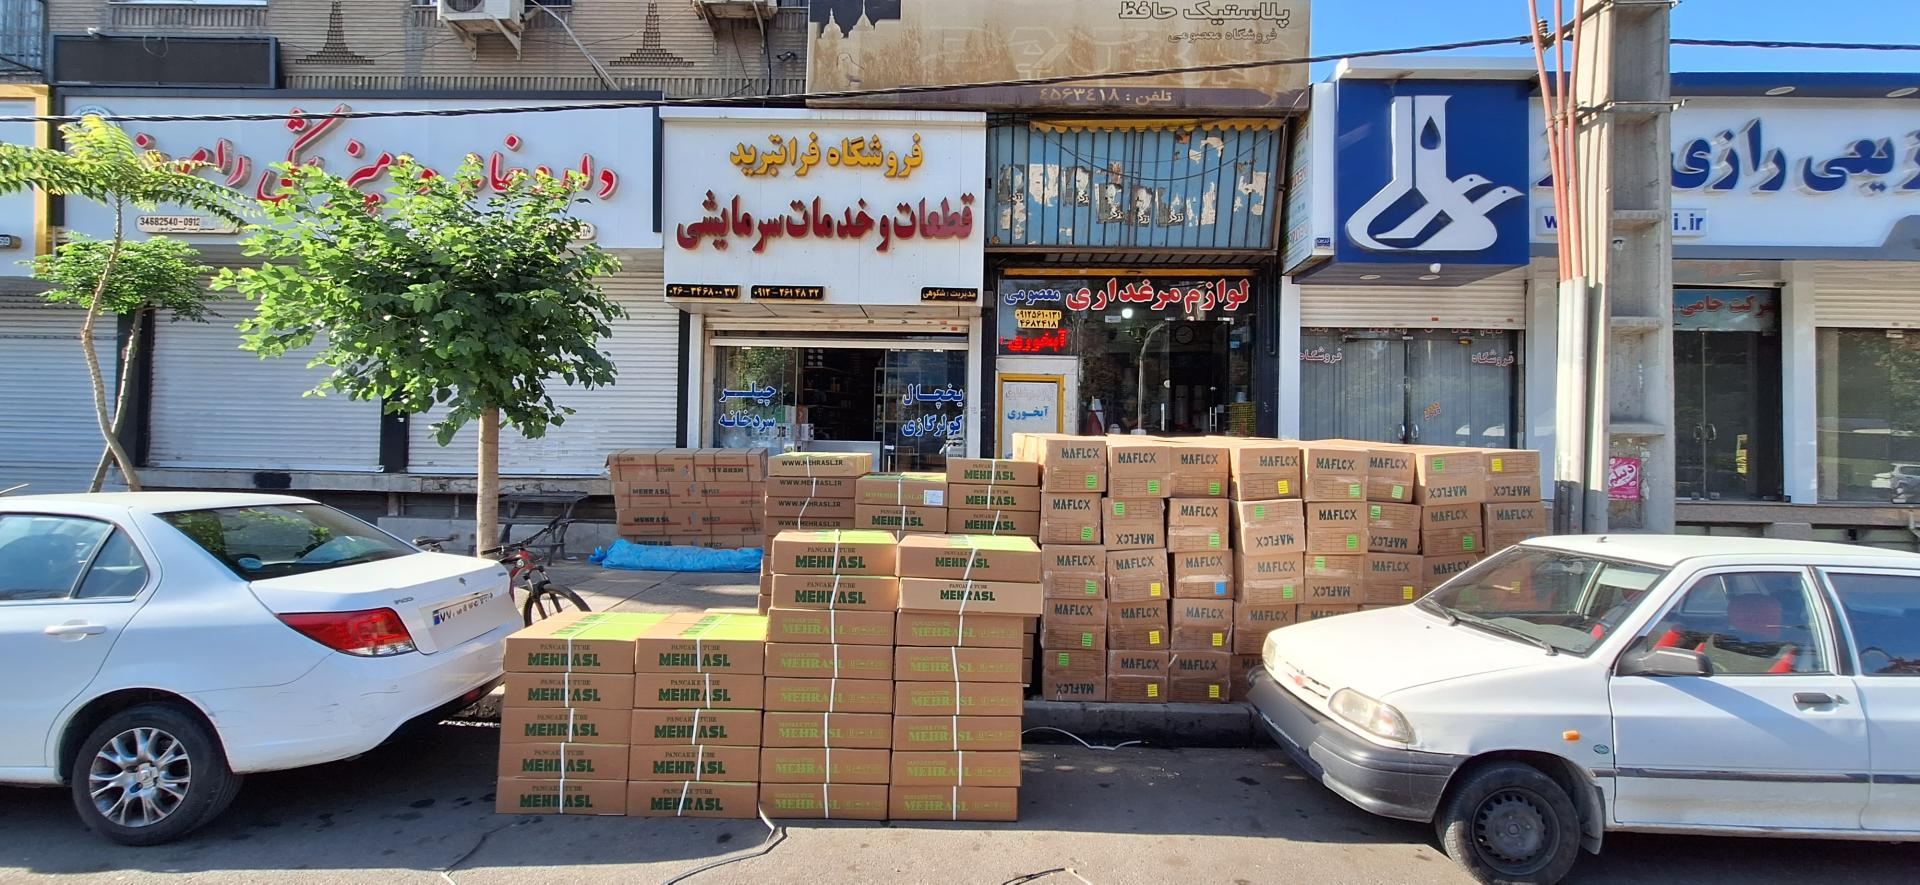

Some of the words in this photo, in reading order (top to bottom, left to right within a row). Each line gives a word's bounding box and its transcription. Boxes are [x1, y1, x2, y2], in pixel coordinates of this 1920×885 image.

[1118, 1, 1178, 21] حافظ
[1183, 1, 1291, 28] پلاستیک
[1167, 30, 1222, 43] معصومی
[1224, 28, 1278, 44] فروشگاه
[1135, 90, 1173, 106] تلفن
[826, 131, 924, 178] فروشگاه
[677, 189, 785, 251] سرمایشی
[785, 195, 876, 241] خدمات
[893, 191, 976, 241] قطعات
[876, 213, 891, 253] و
[1004, 288, 1061, 306] معصومی
[1066, 277, 1182, 311] مرغداری
[1184, 278, 1250, 313] لوازم
[1680, 294, 1724, 317] حامی
[719, 380, 777, 406] چیلر
[902, 383, 964, 409] یخچال
[718, 410, 776, 432] سردخانه
[1006, 405, 1050, 423] آبخوری
